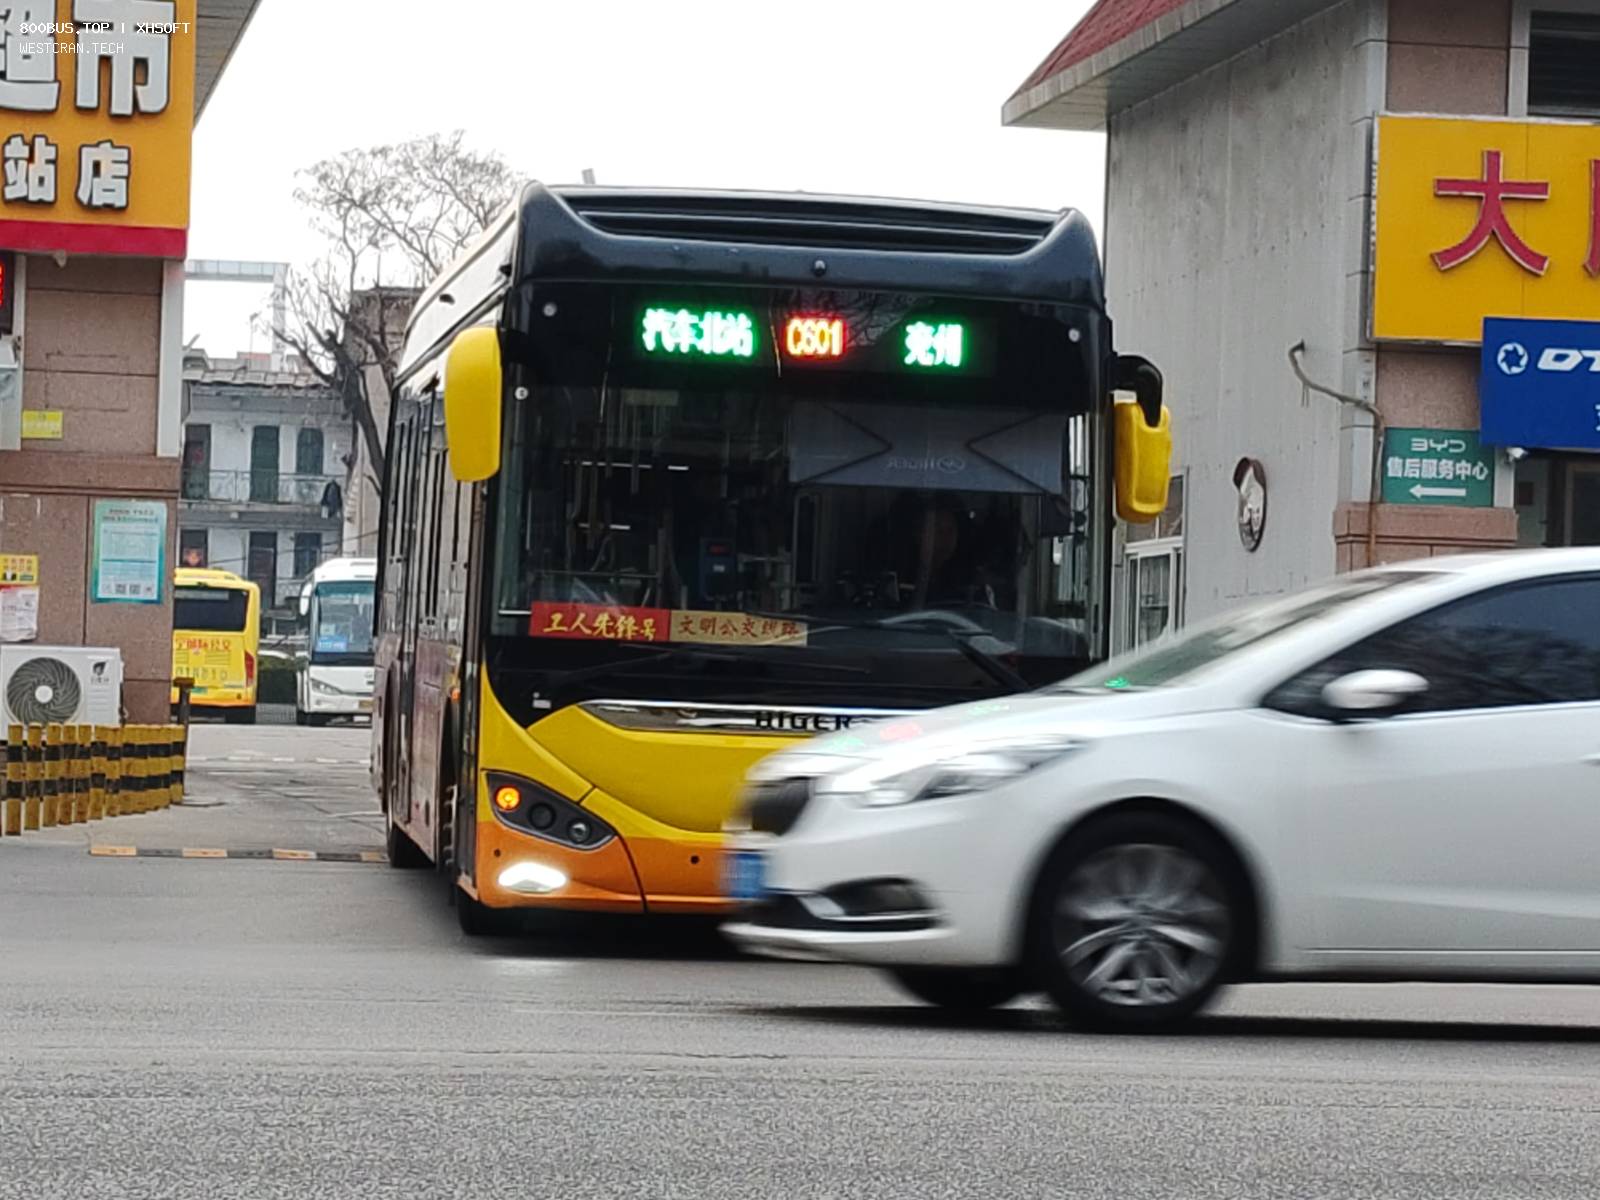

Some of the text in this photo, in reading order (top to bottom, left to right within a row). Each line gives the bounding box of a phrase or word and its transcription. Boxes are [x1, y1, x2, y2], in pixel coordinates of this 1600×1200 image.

[3, 133, 130, 209] 站店
[642, 307, 754, 357] 汽车北站
[1387, 456, 1489, 480] 售后服务中心
[543, 611, 656, 641] 工人先锋号
[755, 711, 851, 731] HIGER
